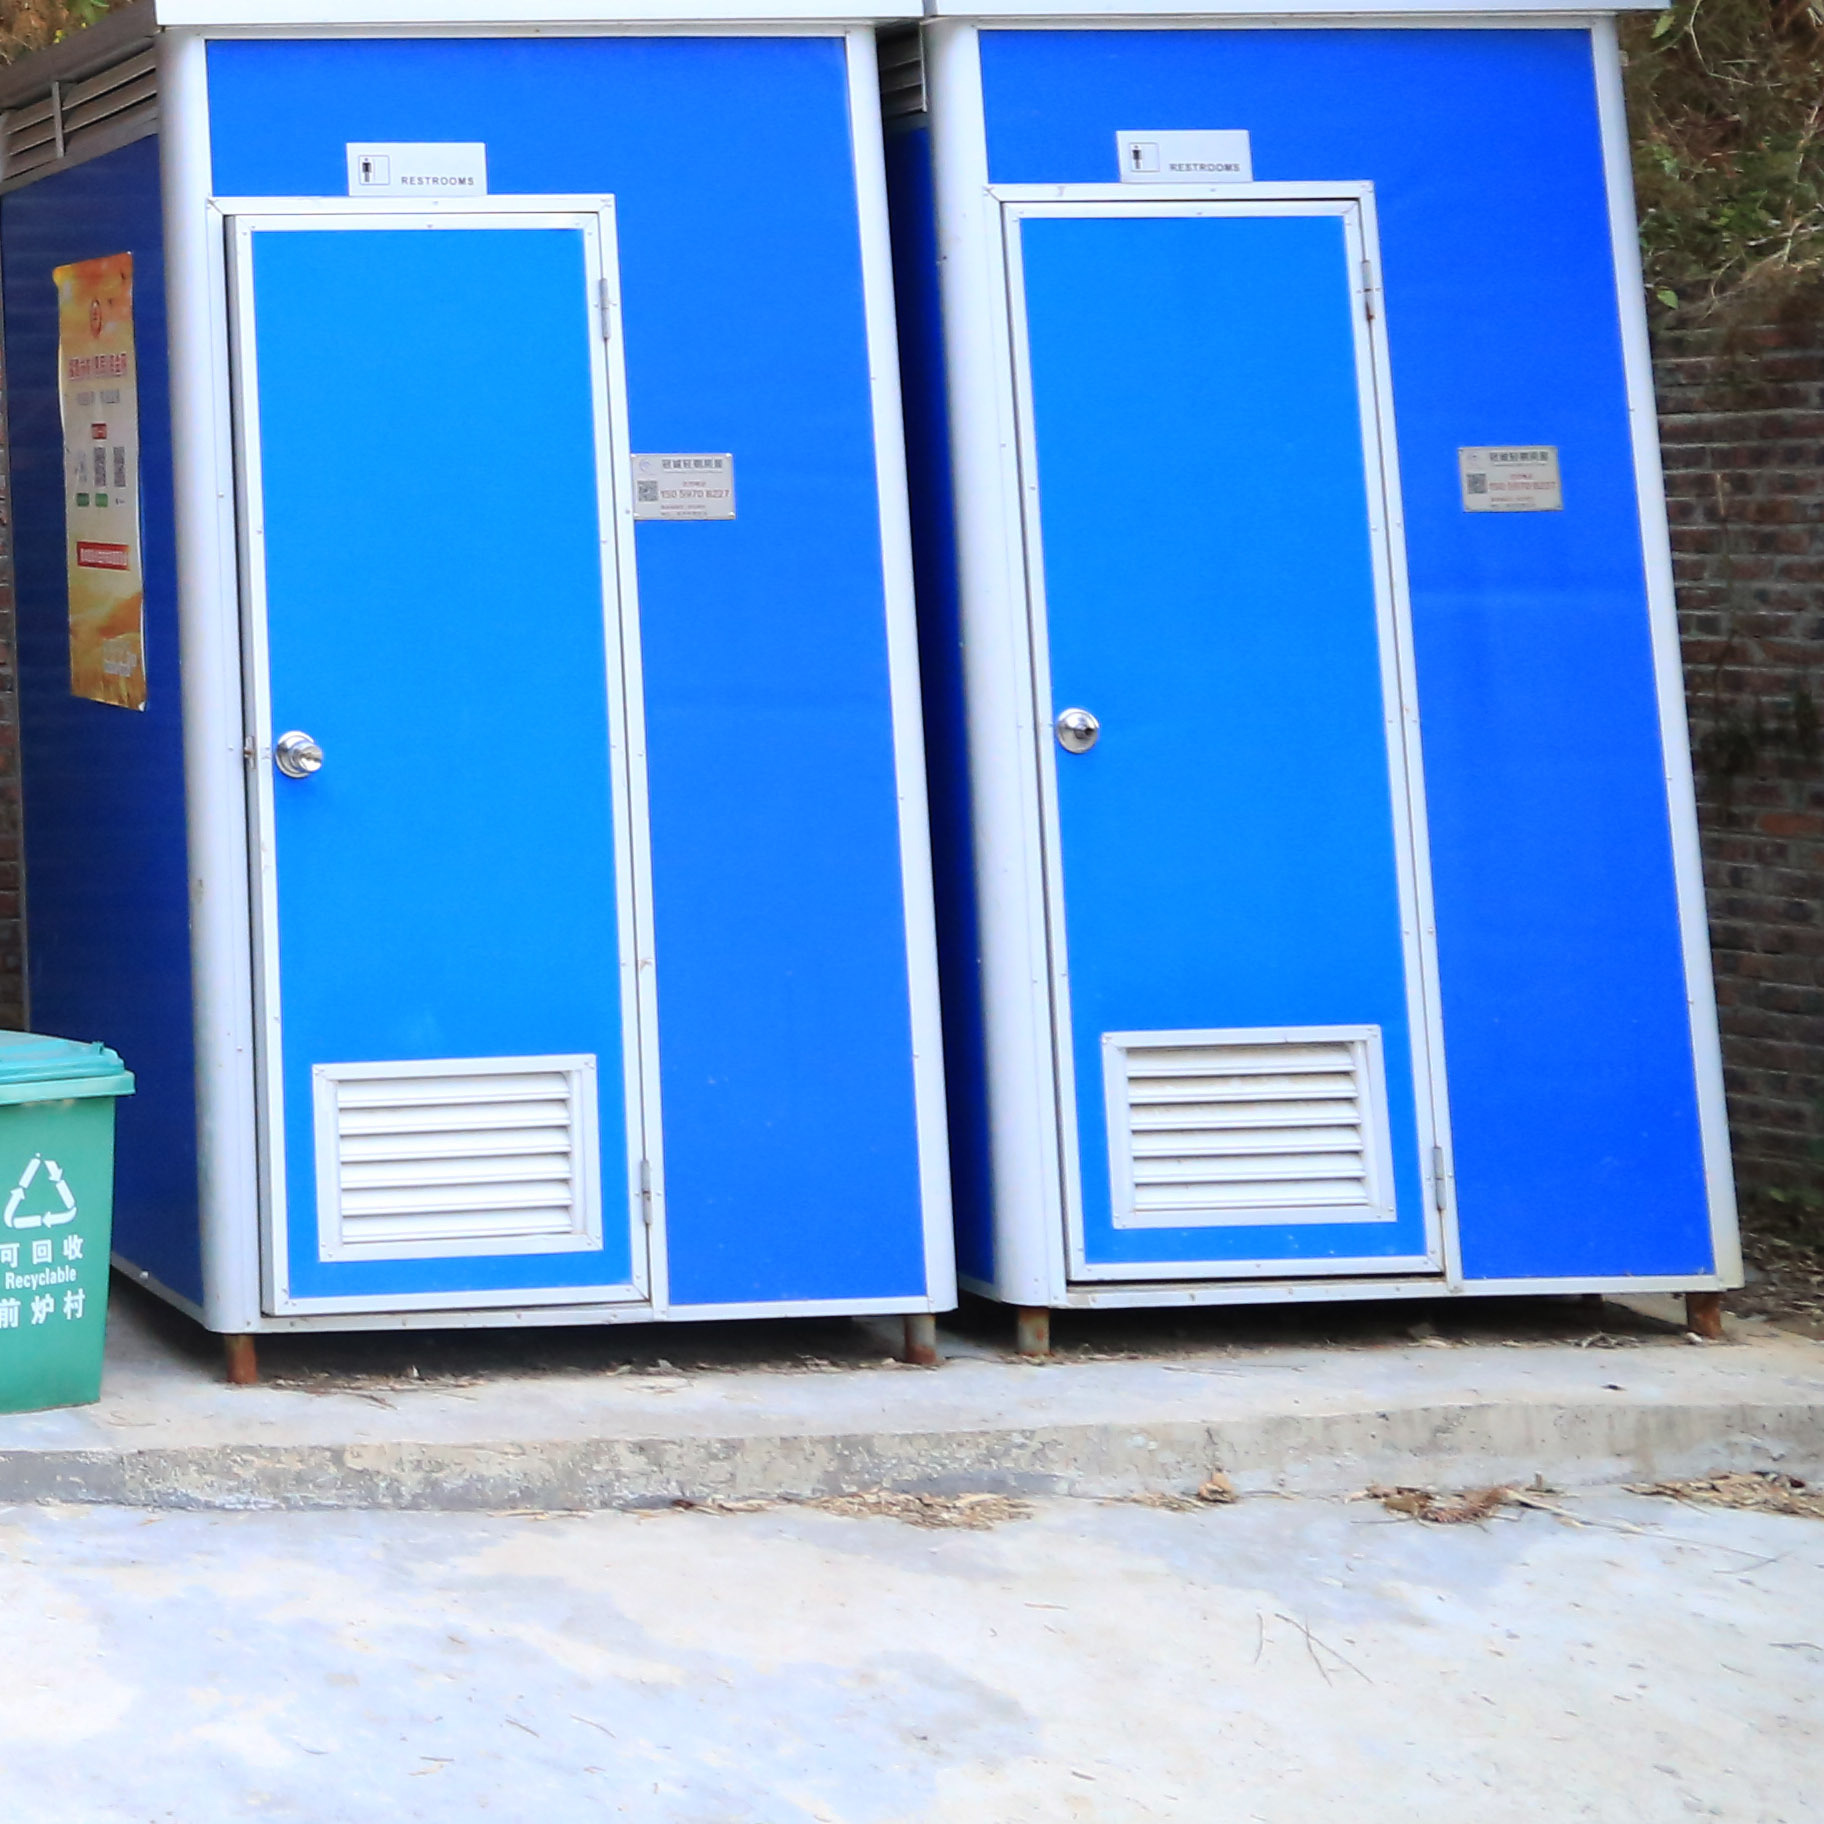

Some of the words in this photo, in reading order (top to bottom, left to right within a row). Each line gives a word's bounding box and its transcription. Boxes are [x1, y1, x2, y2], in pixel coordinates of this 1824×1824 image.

[1170, 163, 1240, 172] RESTROOMS
[401, 176, 474, 185] RESTROOMS
[5, 1265, 77, 1291] Recyclable
